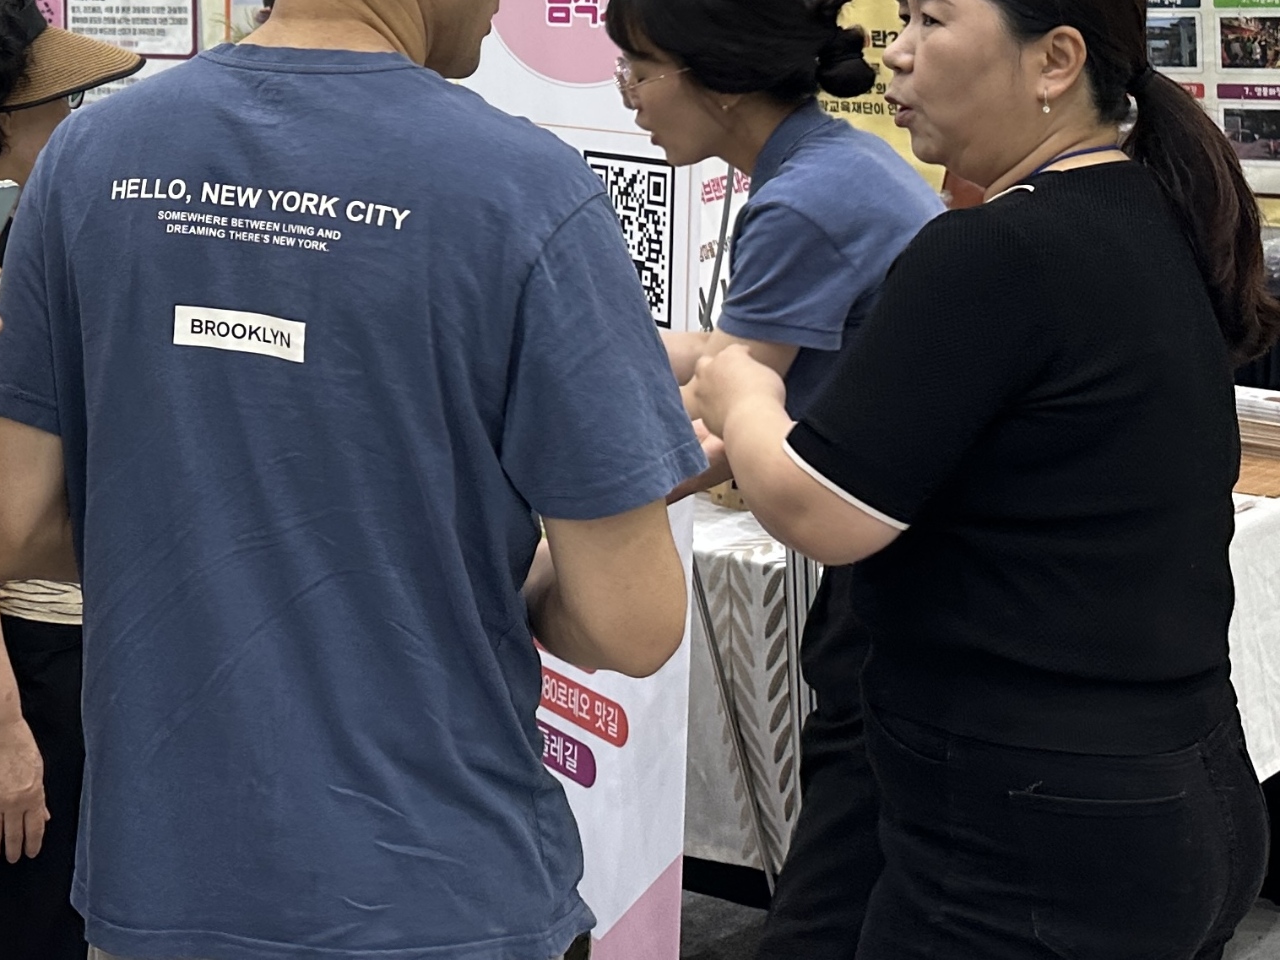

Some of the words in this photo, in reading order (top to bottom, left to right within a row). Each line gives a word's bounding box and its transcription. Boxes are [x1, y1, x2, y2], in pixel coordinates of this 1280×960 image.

[111, 178, 192, 204] HELLO,
[200, 182, 262, 209] NEW
[267, 190, 339, 218] YORK
[345, 200, 411, 230] CITY
[157, 210, 228, 227] SOMEWHERE
[230, 218, 280, 232] BETWEEN
[282, 222, 315, 237] LIVING
[317, 228, 341, 241] AND
[166, 225, 226, 239] DREAMING
[228, 230, 270, 244] THERE'S
[272, 235, 297, 248] NEW
[297, 239, 330, 252] YORK.
[190, 318, 291, 349] BROOKLYN
[593, 700, 618, 738] 맛길
